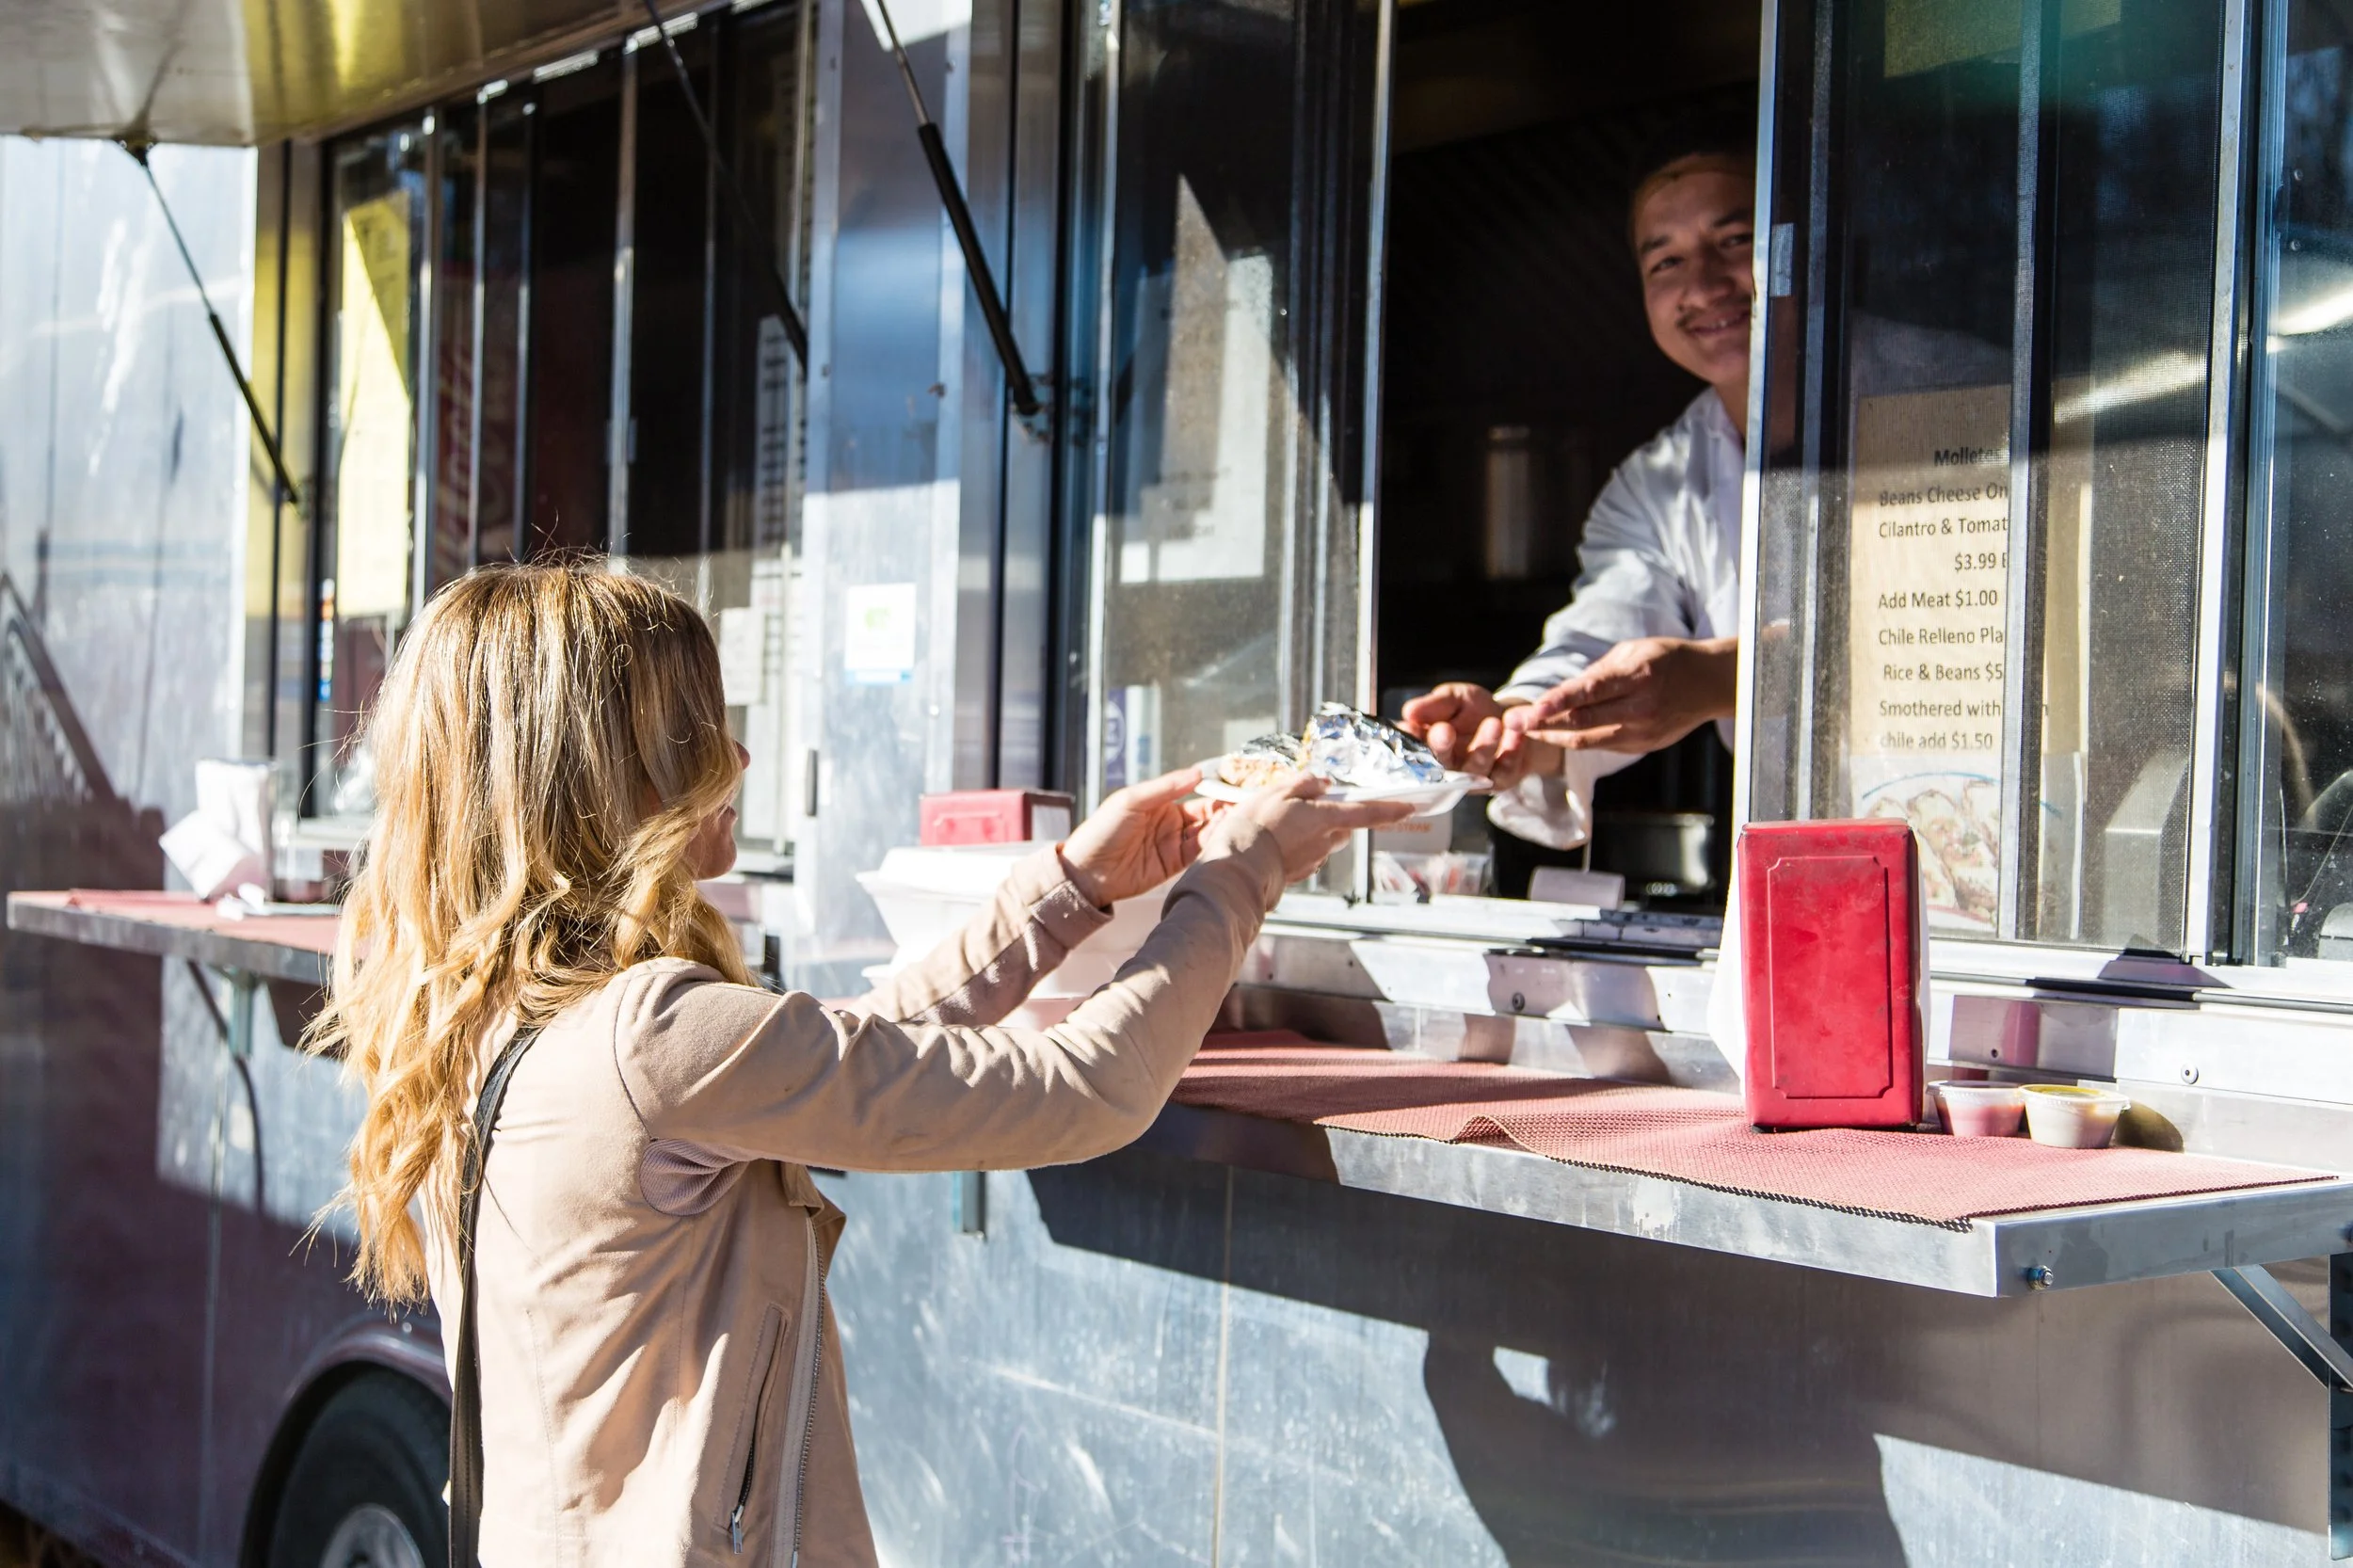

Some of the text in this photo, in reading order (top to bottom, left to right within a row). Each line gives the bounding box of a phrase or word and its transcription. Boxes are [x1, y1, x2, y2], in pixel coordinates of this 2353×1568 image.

[1880, 488, 1922, 506] Beans
[1928, 485, 1980, 504] Cheese
[1879, 520, 1936, 538] Cilantro
[1941, 518, 1953, 536] &
[1955, 552, 1995, 574] $3.99
[1879, 588, 1997, 609] Add Meat $1.00
[1879, 628, 1914, 646] Chile
[1919, 627, 1975, 644] Relleno
[1883, 663, 1913, 680] Rice
[1918, 662, 1929, 680] &
[1936, 664, 1980, 680] Beans
[1880, 699, 2001, 717] Smothered with
[1919, 730, 1946, 749] add
[1951, 730, 1993, 751] $1.50
